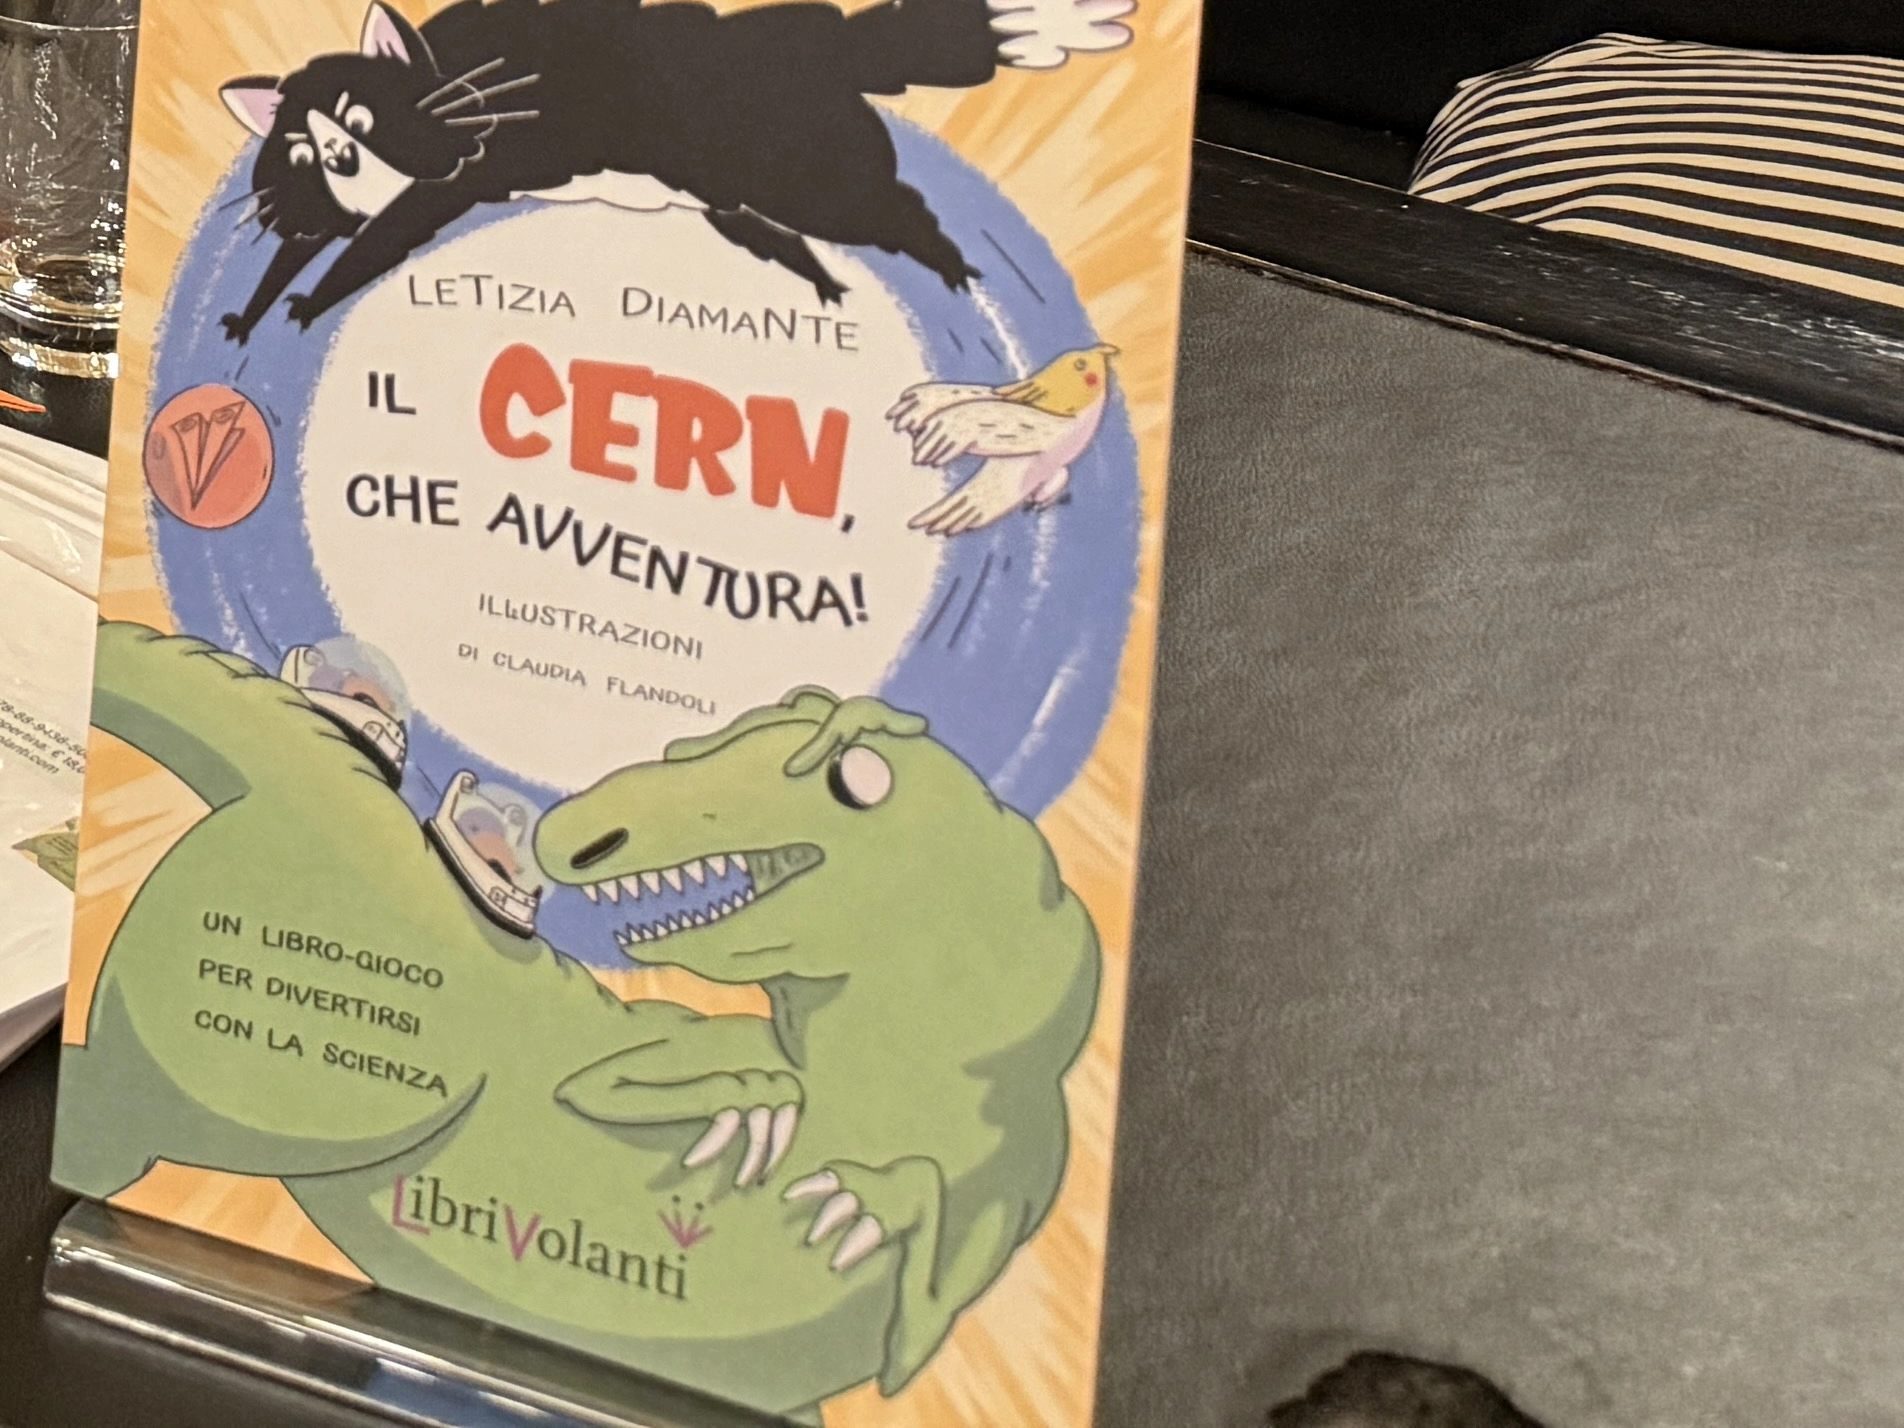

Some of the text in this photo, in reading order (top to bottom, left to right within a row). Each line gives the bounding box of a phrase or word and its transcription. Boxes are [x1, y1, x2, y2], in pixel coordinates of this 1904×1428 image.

[409, 274, 859, 351] LETIZIA DIAMANTE
[367, 343, 856, 533] IL CERN,
[346, 473, 869, 628] CHE AVVENTURA!
[478, 593, 703, 660] ILLUSTRAZIONI
[457, 643, 716, 716] DI CLAUDIA FLANDOLI
[202, 911, 444, 990] UN LIBRO-GIOCO
[198, 958, 422, 1037] PER DIVERTIRSI
[194, 1009, 449, 1099] CON LA SCIENZA
[391, 1172, 689, 1301] LibriVolanti
